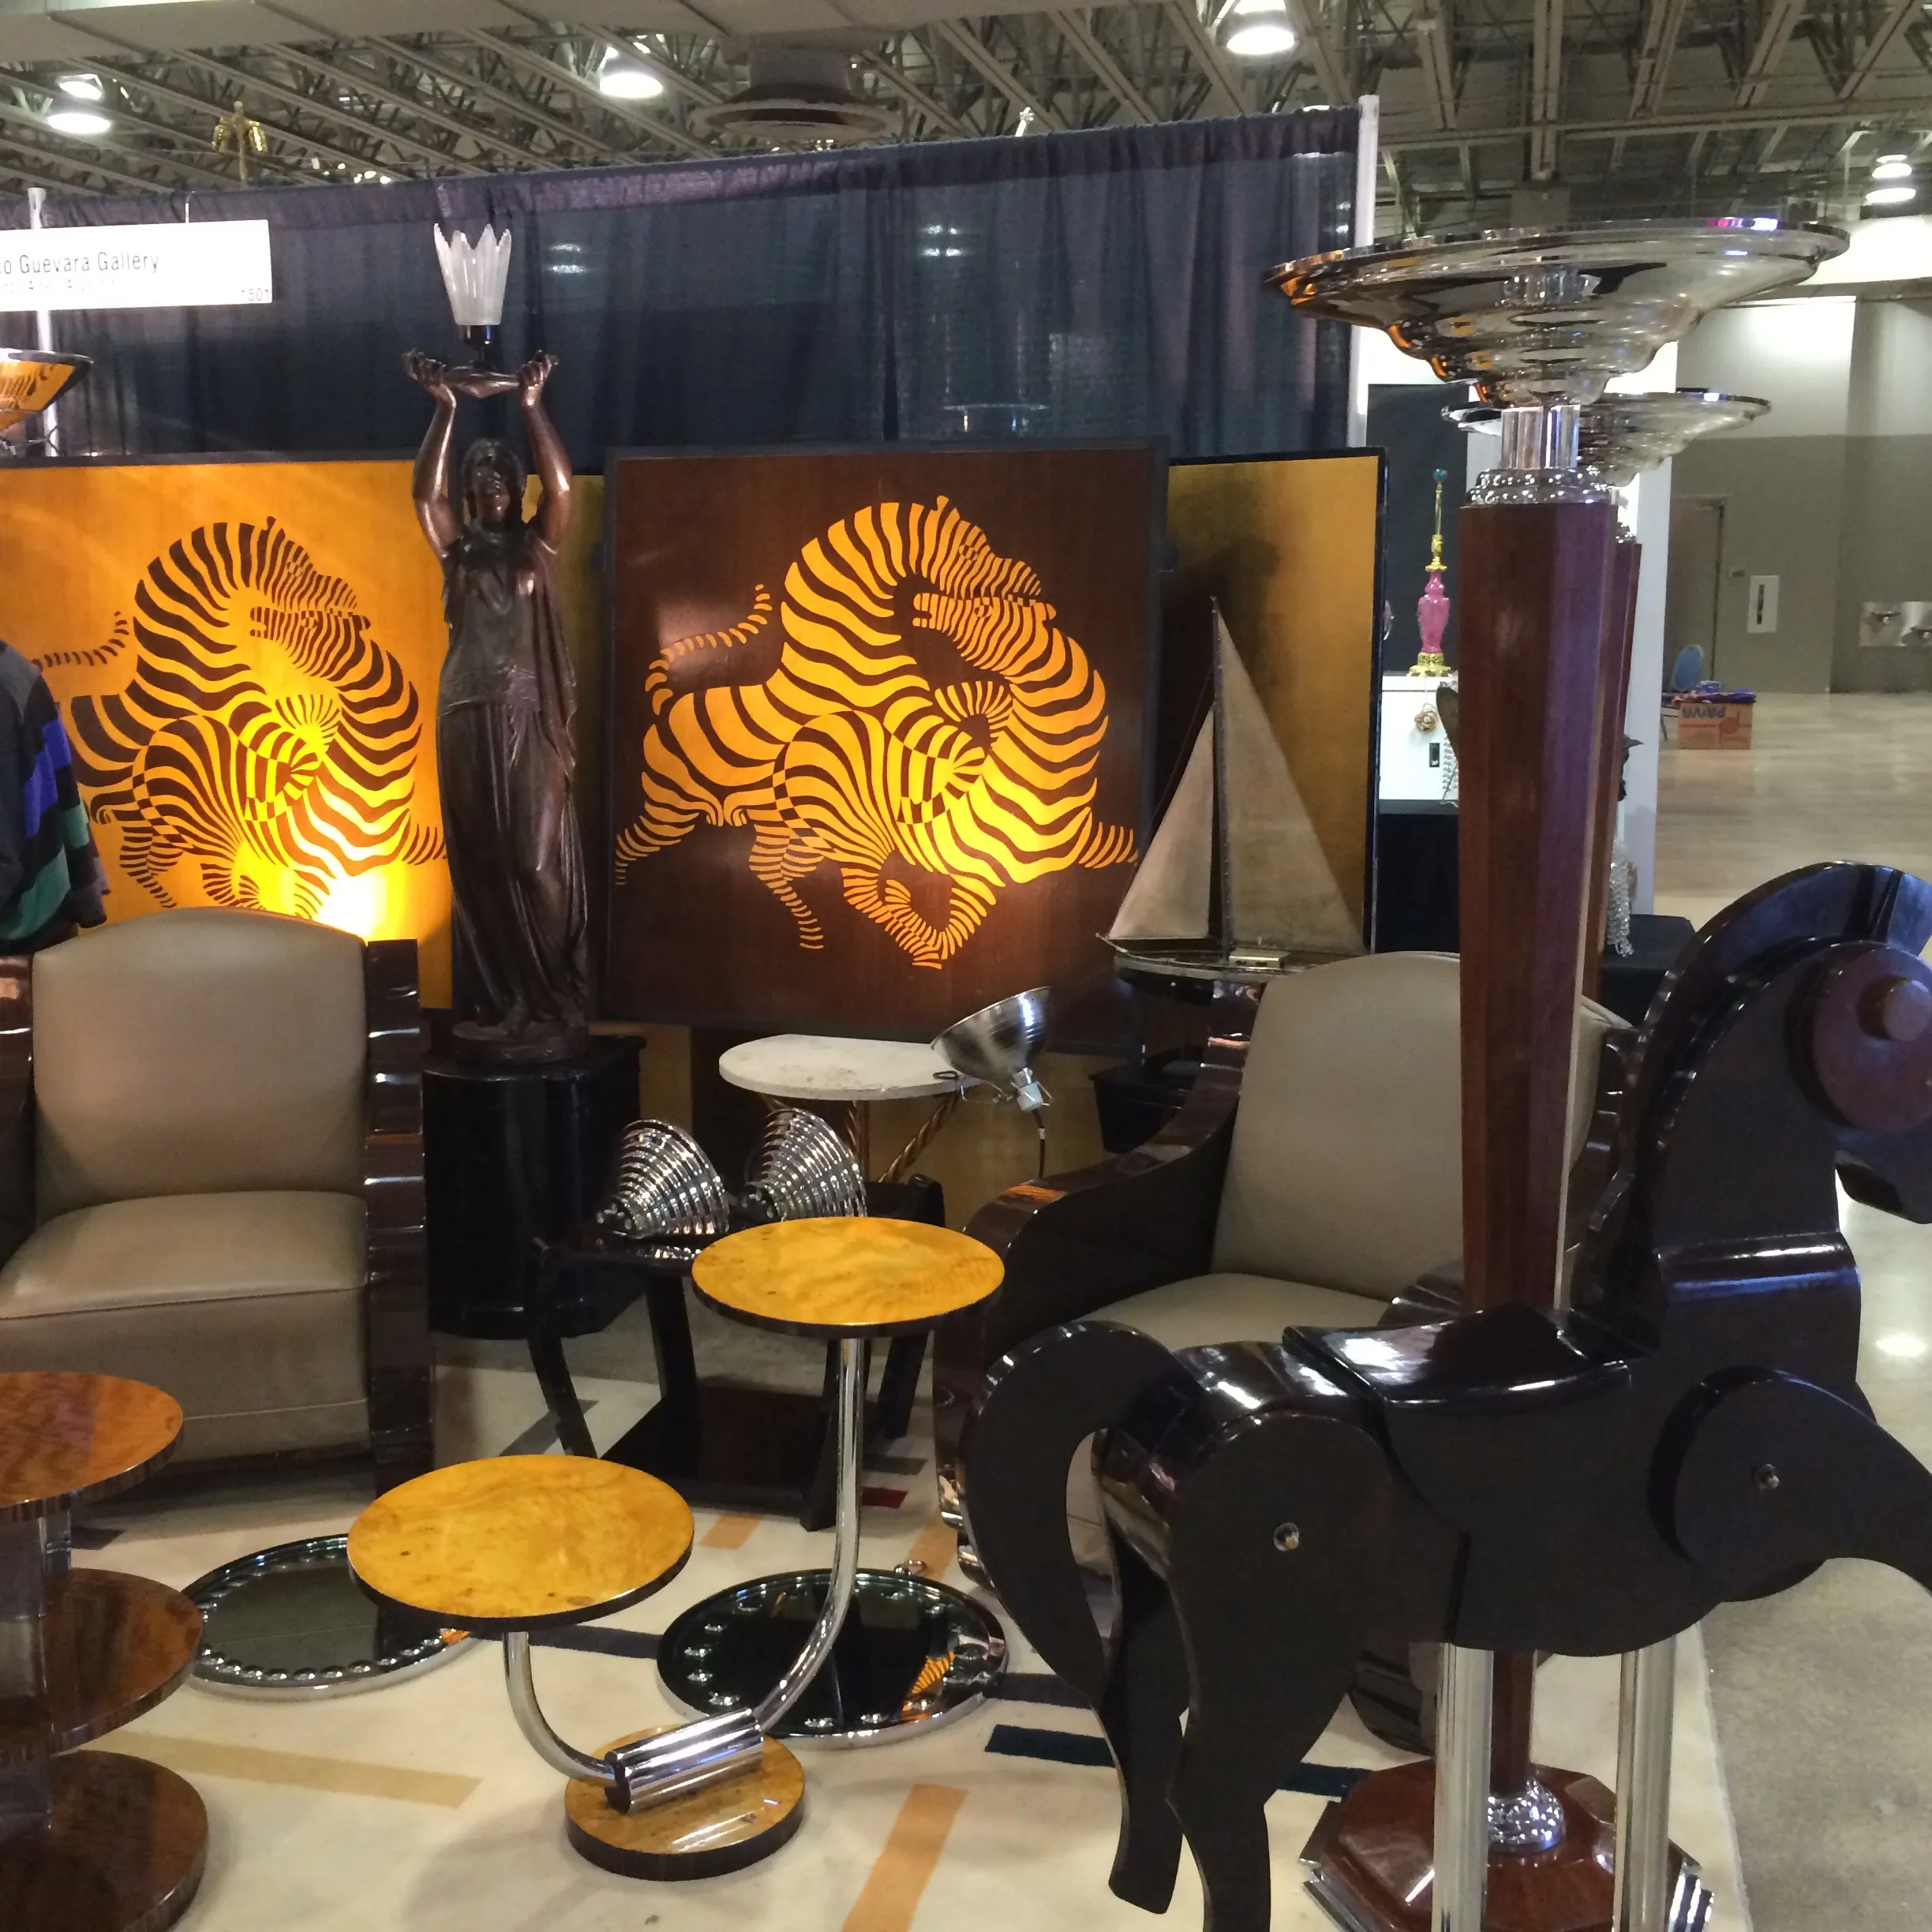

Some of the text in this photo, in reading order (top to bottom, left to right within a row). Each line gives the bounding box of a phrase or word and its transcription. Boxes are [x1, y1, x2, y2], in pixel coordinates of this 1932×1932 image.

[0, 251, 159, 274] o Guevara Gallery
